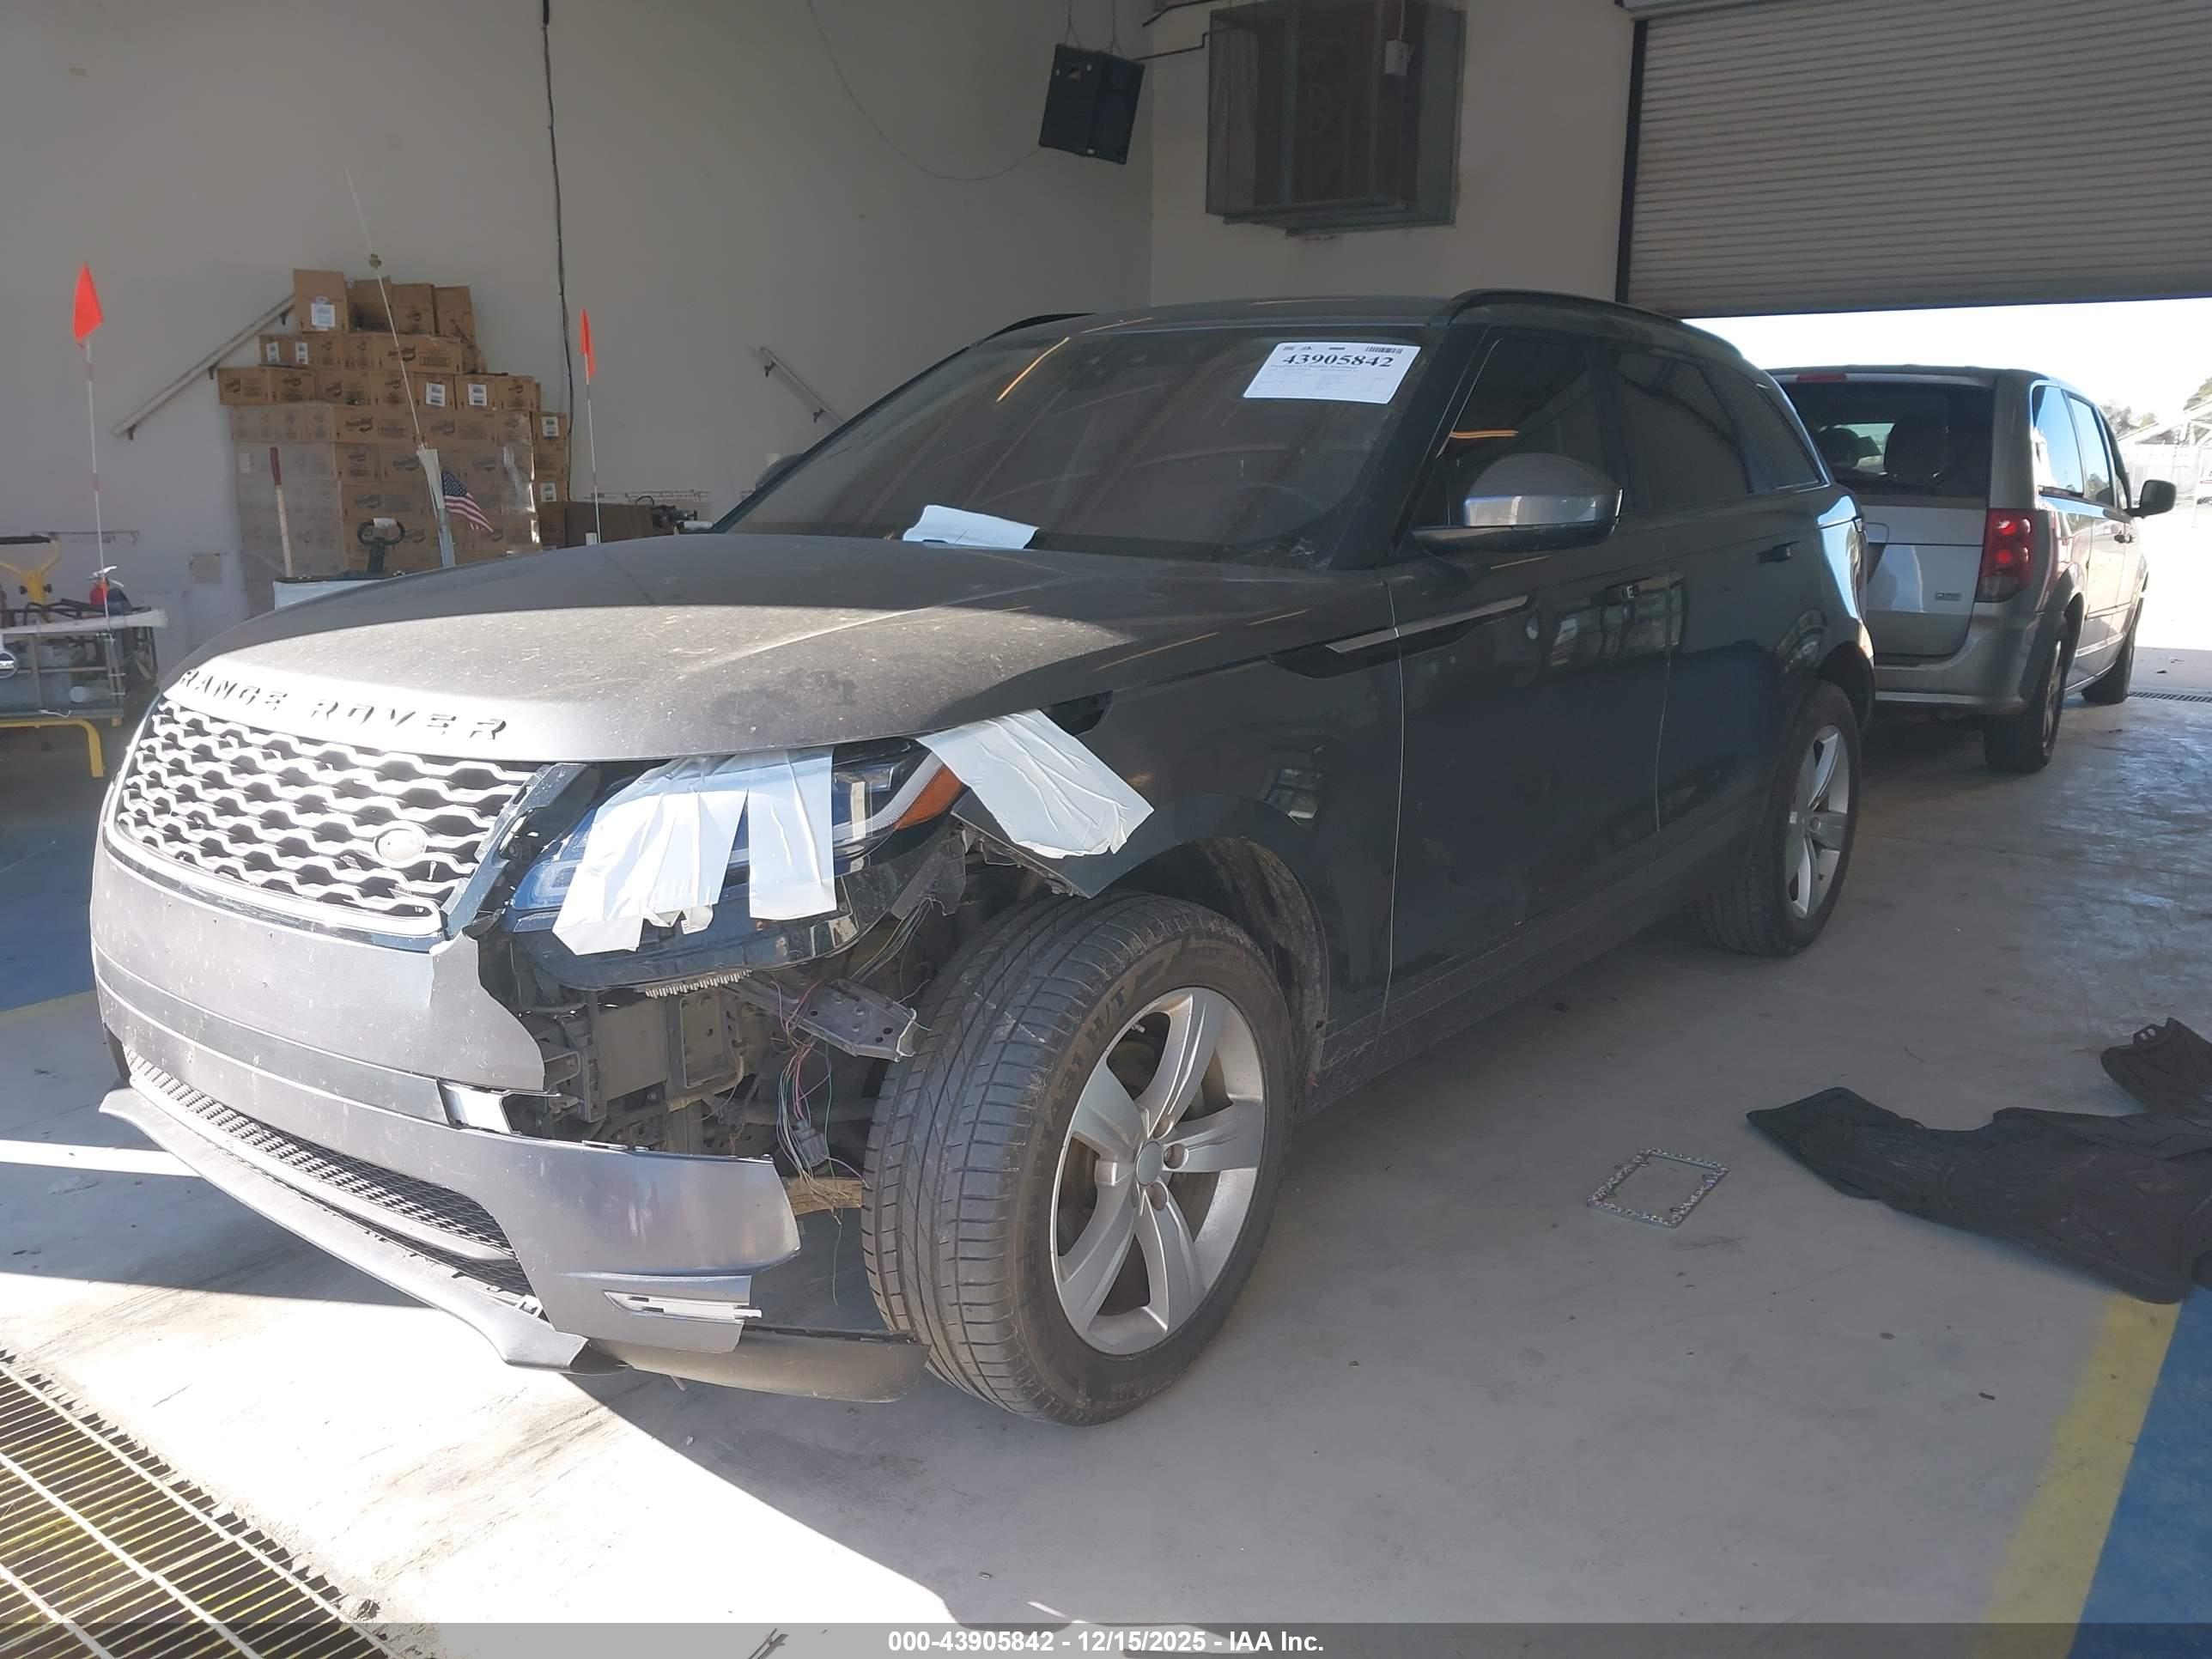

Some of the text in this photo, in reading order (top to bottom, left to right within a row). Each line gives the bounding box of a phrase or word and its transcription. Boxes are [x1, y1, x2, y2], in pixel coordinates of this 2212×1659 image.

[1283, 354, 1394, 368] 43905842
[179, 669, 507, 740] RANGE ROVER
